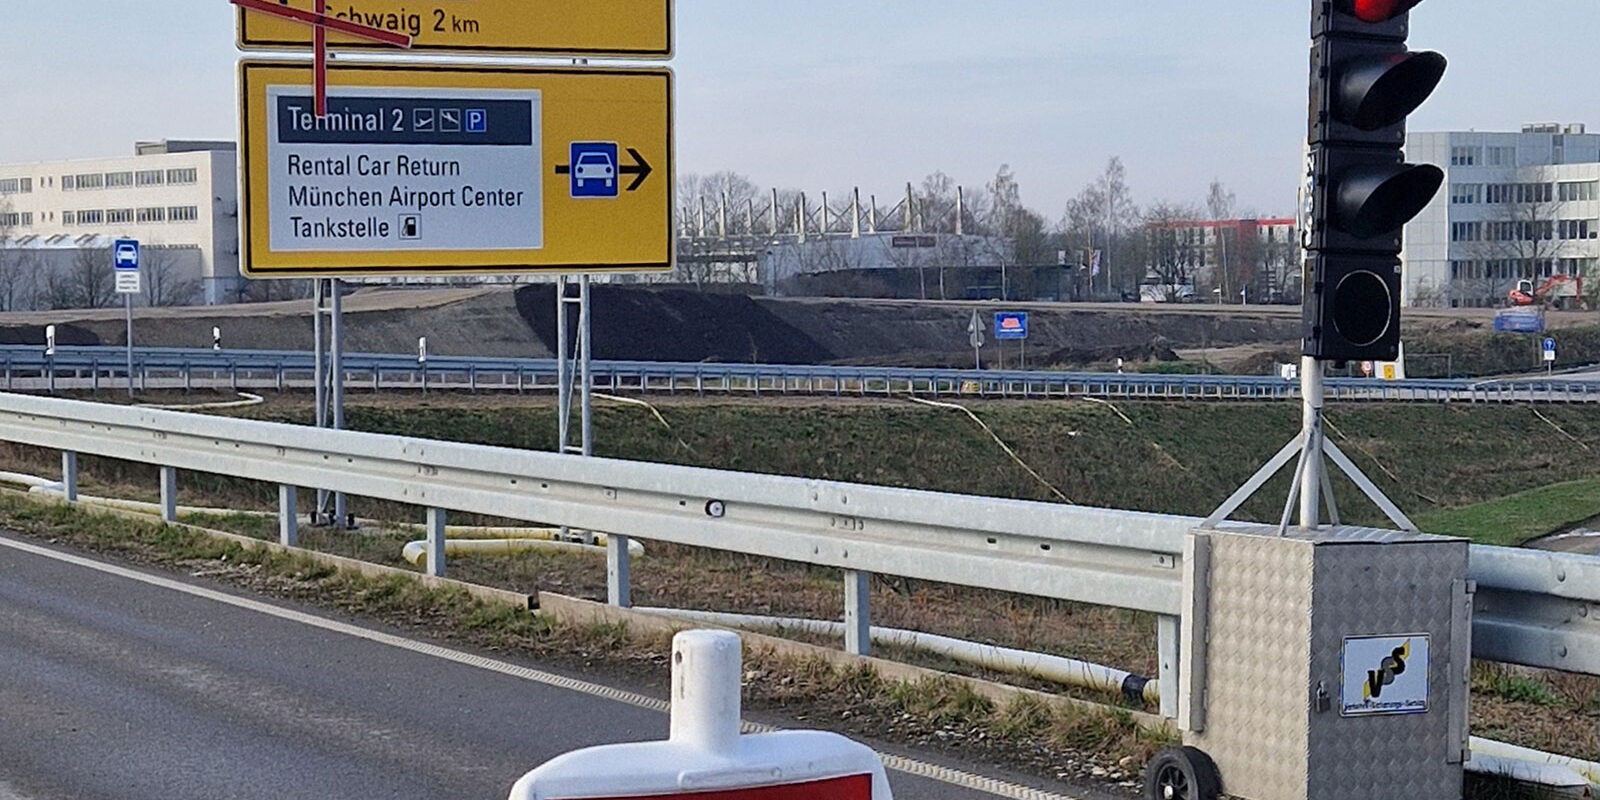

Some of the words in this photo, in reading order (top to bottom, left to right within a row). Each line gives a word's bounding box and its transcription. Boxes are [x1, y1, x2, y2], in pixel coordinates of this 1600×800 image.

[433, 8, 445, 32] 2
[452, 15, 480, 33] km
[287, 106, 384, 131] Terminal
[391, 108, 404, 132] 2
[288, 154, 351, 176] Rental
[357, 154, 391, 176] Car
[397, 155, 460, 176] Return
[288, 185, 382, 207] München
[389, 186, 456, 211] Airport
[462, 185, 524, 208] Center
[290, 216, 390, 238] Tankstelle
